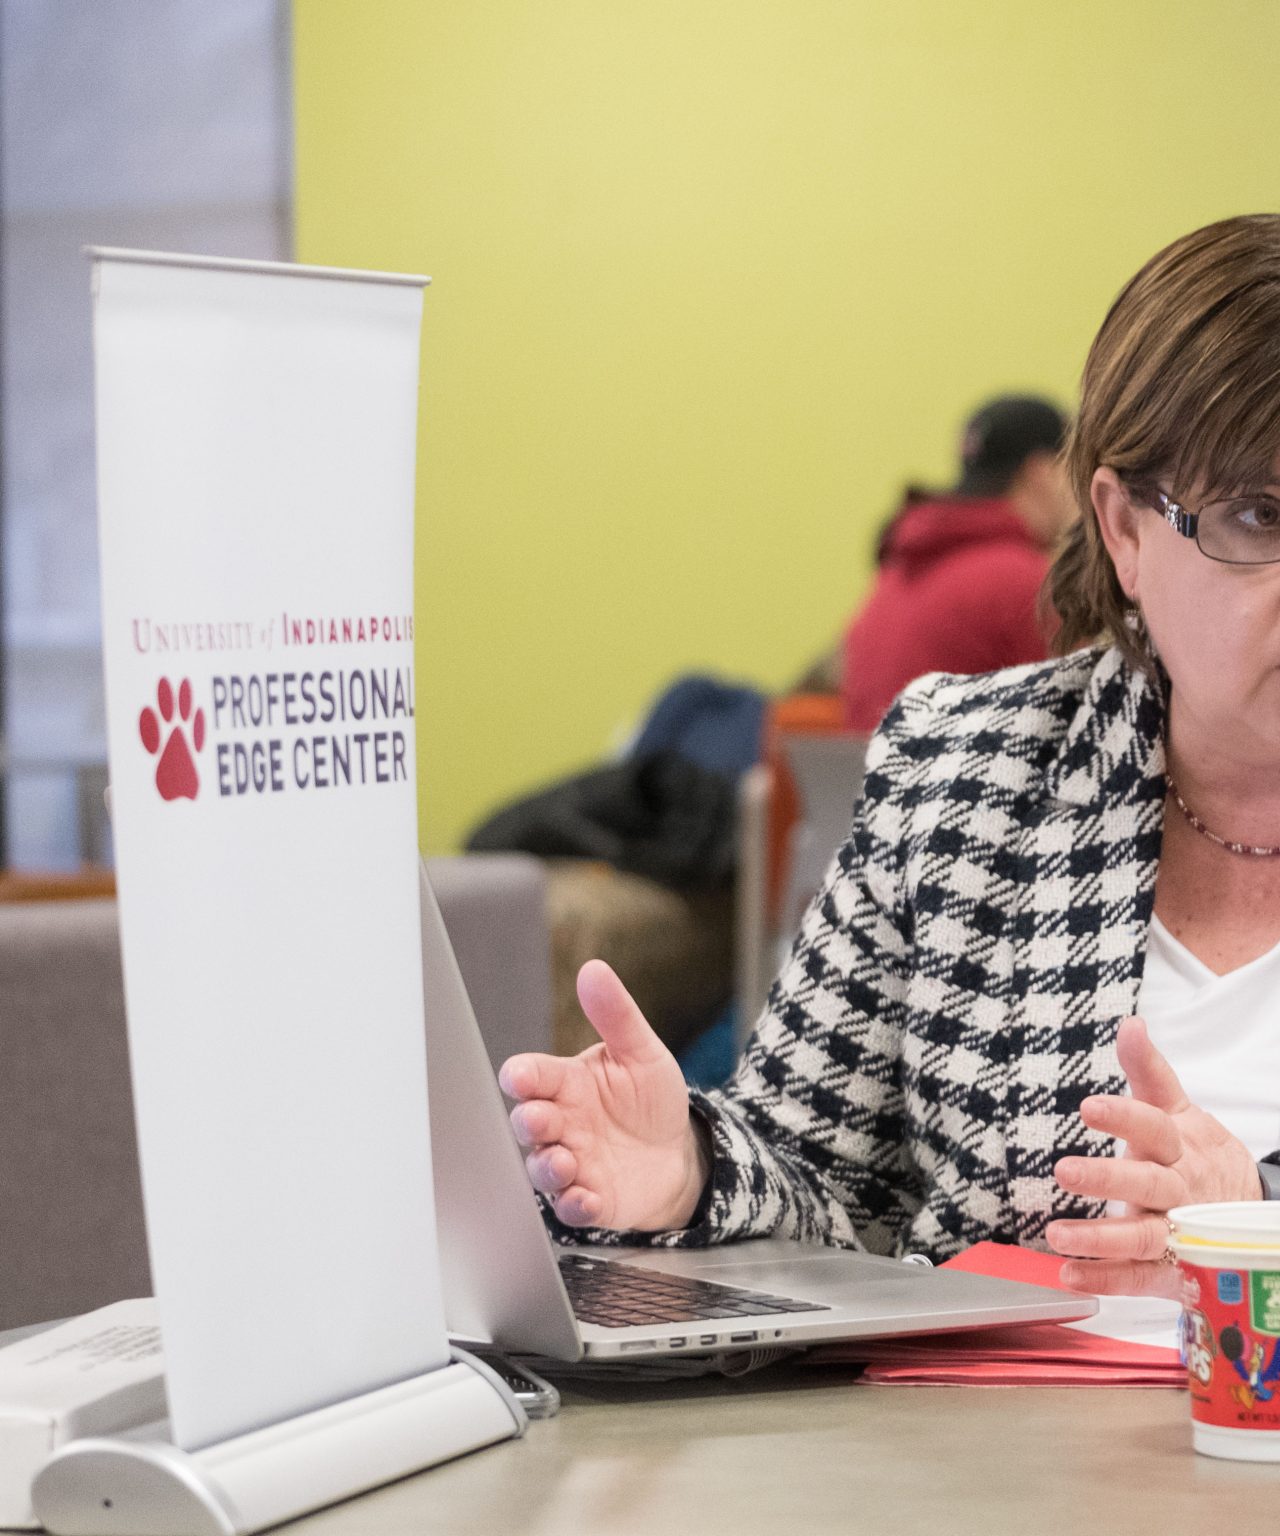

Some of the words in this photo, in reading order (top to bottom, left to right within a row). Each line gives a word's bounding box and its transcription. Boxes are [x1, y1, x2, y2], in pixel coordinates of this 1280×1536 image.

[212, 666, 414, 730] PROFESSIONAL
[216, 739, 285, 798] EDGE
[293, 730, 408, 790] CENTER
